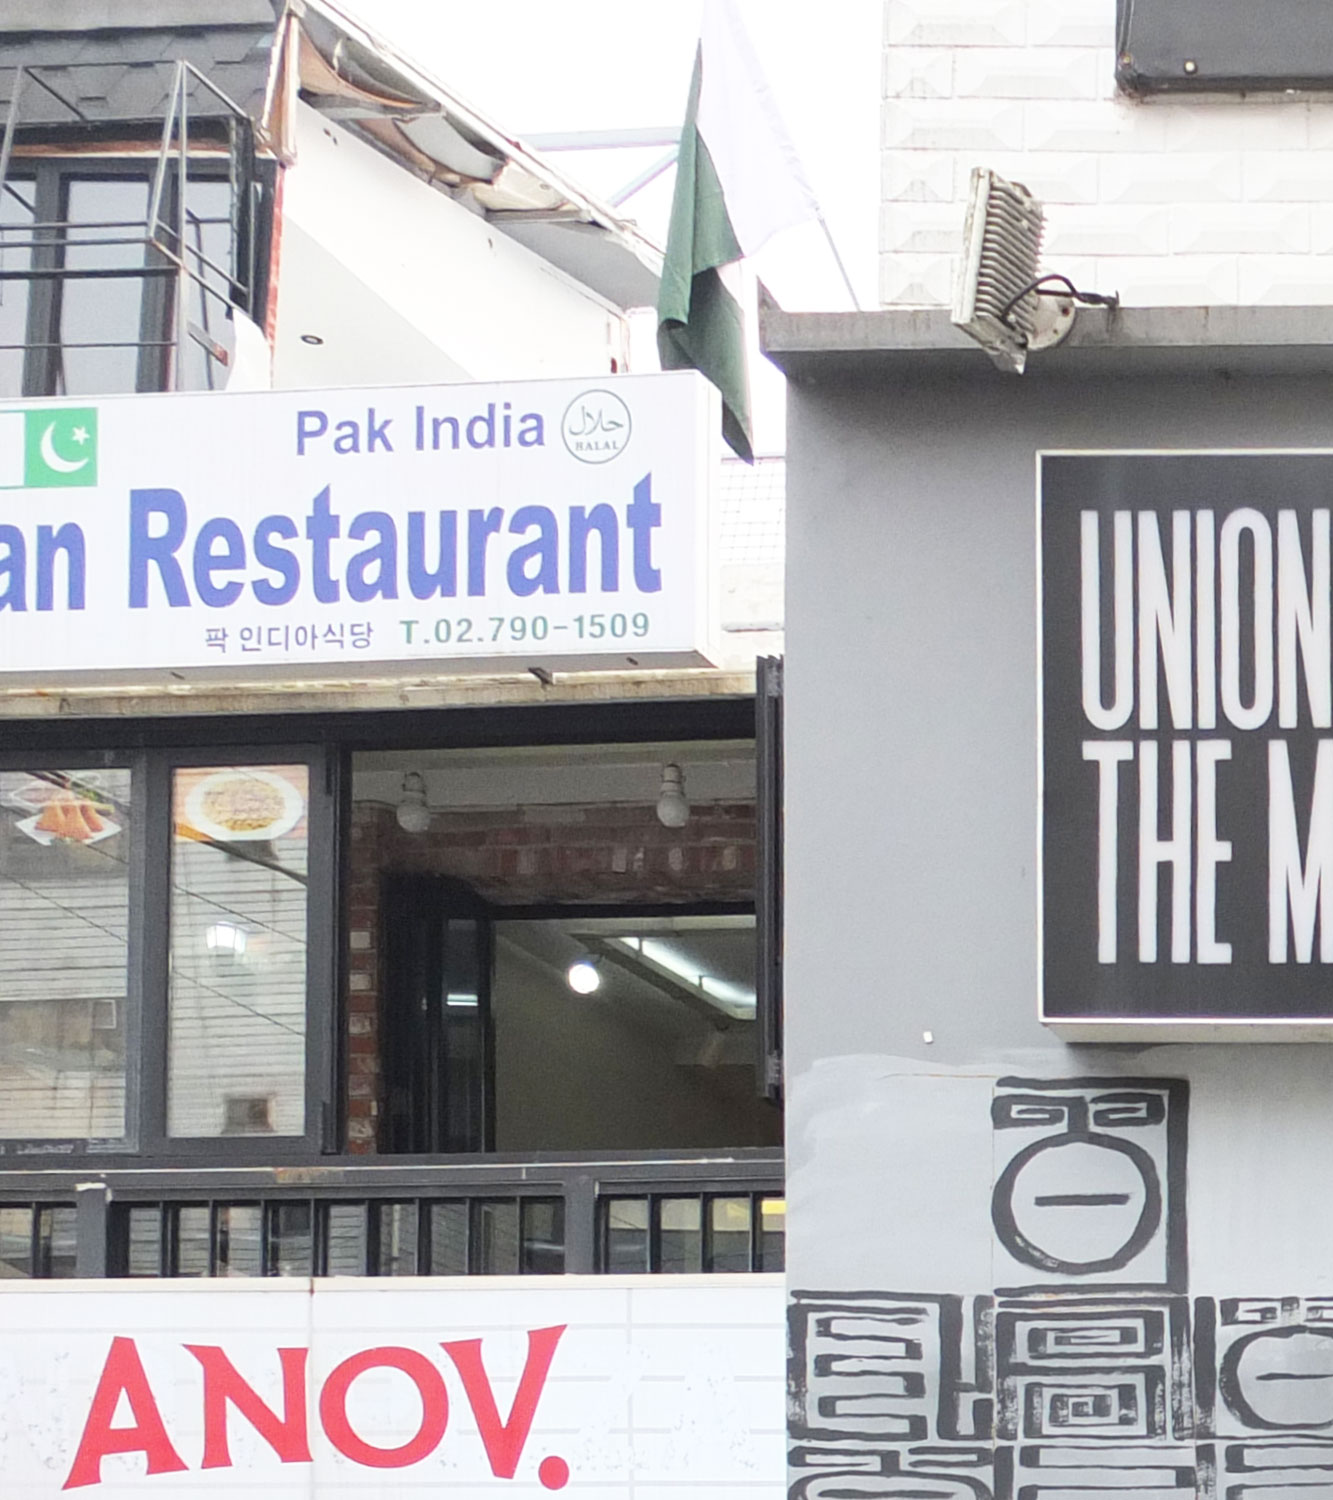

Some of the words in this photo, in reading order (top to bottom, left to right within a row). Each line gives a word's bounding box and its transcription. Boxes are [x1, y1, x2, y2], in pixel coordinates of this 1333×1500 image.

[296, 408, 394, 455] Pak
[415, 403, 545, 450] India
[575, 440, 620, 451] HALAL
[128, 471, 662, 609] Restaurant
[239, 621, 374, 654] 인디아식당
[399, 612, 650, 646] T.02.790-1509
[1080, 508, 1332, 731] UNION
[1081, 739, 1233, 964] THE
[61, 1324, 570, 1490] ANOV.
